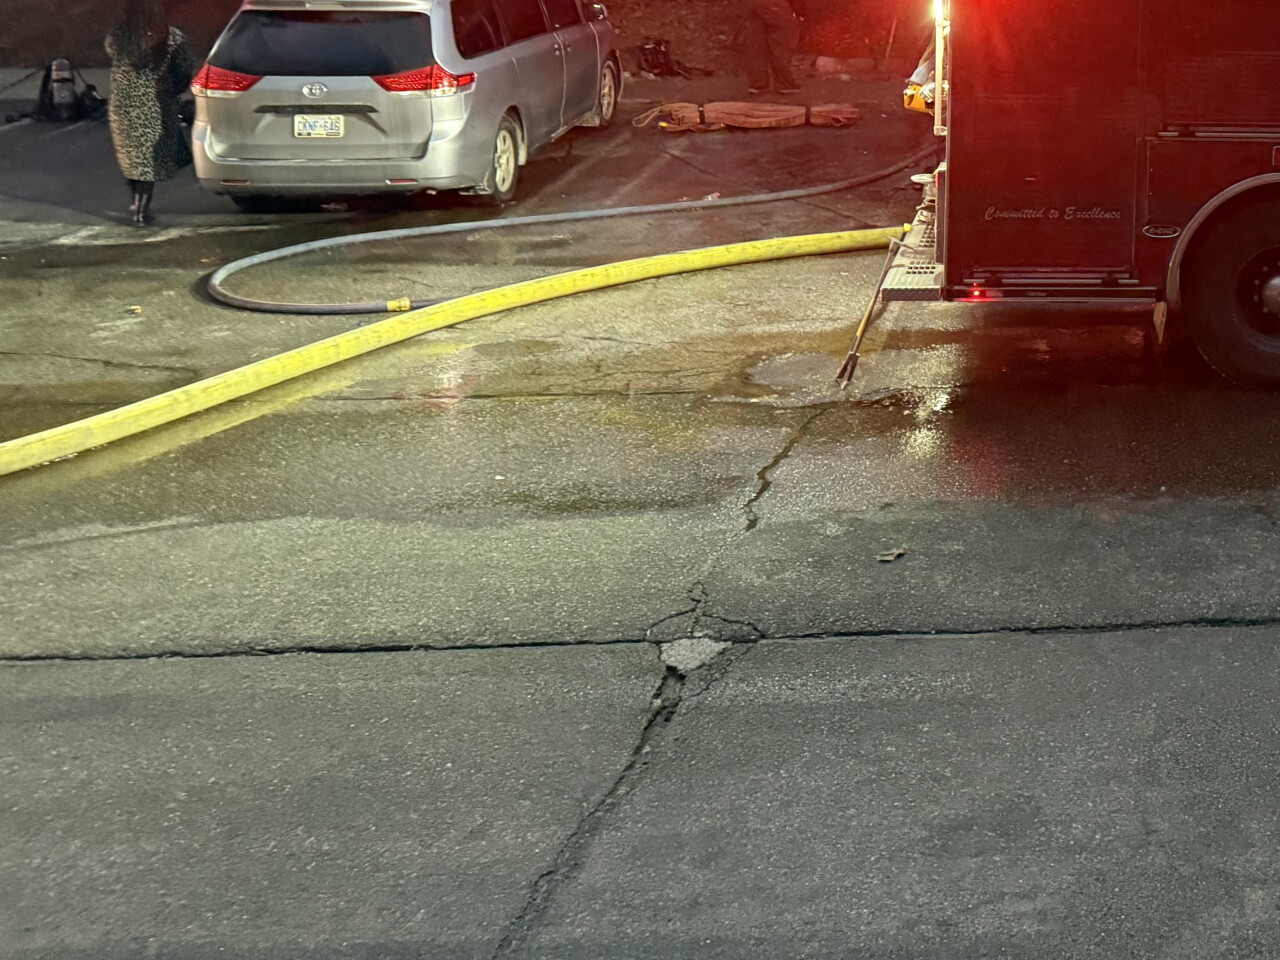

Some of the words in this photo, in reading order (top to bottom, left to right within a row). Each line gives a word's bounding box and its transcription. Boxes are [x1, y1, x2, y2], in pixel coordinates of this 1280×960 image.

[984, 205, 1045, 220] Committed
[1049, 208, 1060, 219] to
[1063, 206, 1122, 220] Excellence
